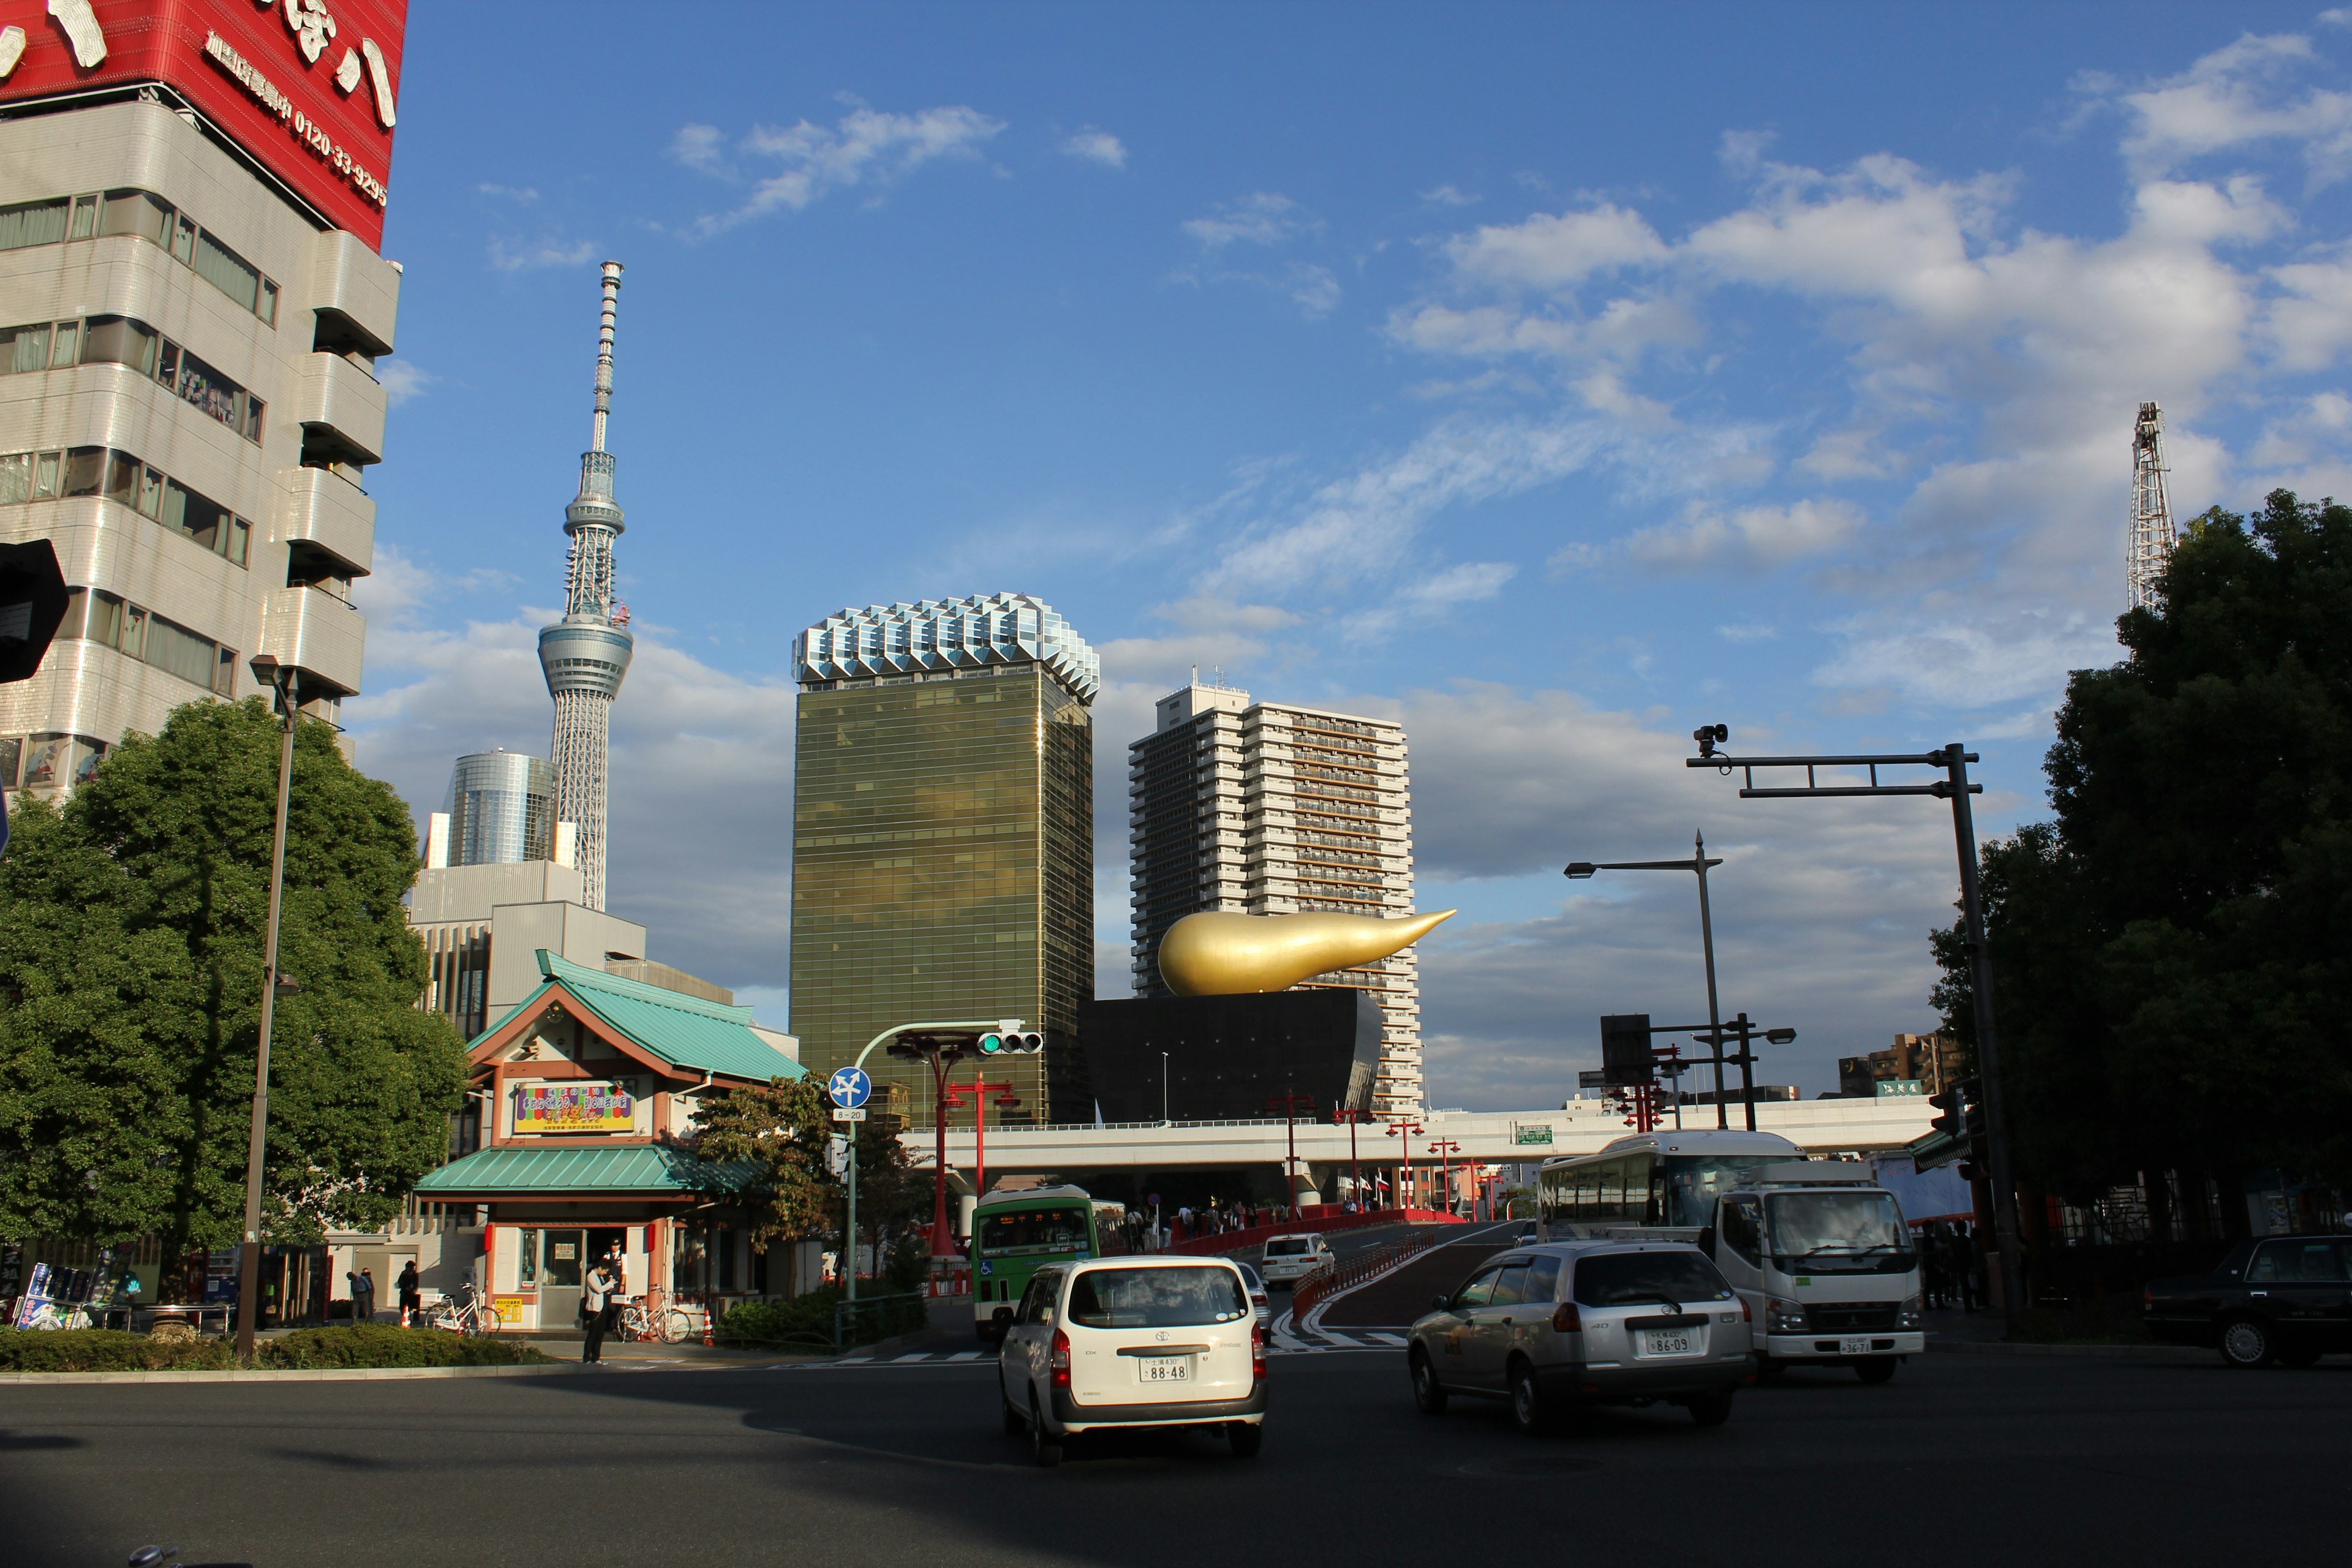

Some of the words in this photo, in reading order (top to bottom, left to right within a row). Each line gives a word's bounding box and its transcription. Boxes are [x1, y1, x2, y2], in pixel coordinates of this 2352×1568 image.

[205, 29, 293, 119] 加盟店募集中
[294, 110, 388, 207] 0120-33-9295
[1657, 1338, 1687, 1352] 86-09
[1847, 1343, 1869, 1353] 36-71
[1151, 1366, 1185, 1379] 88-48
